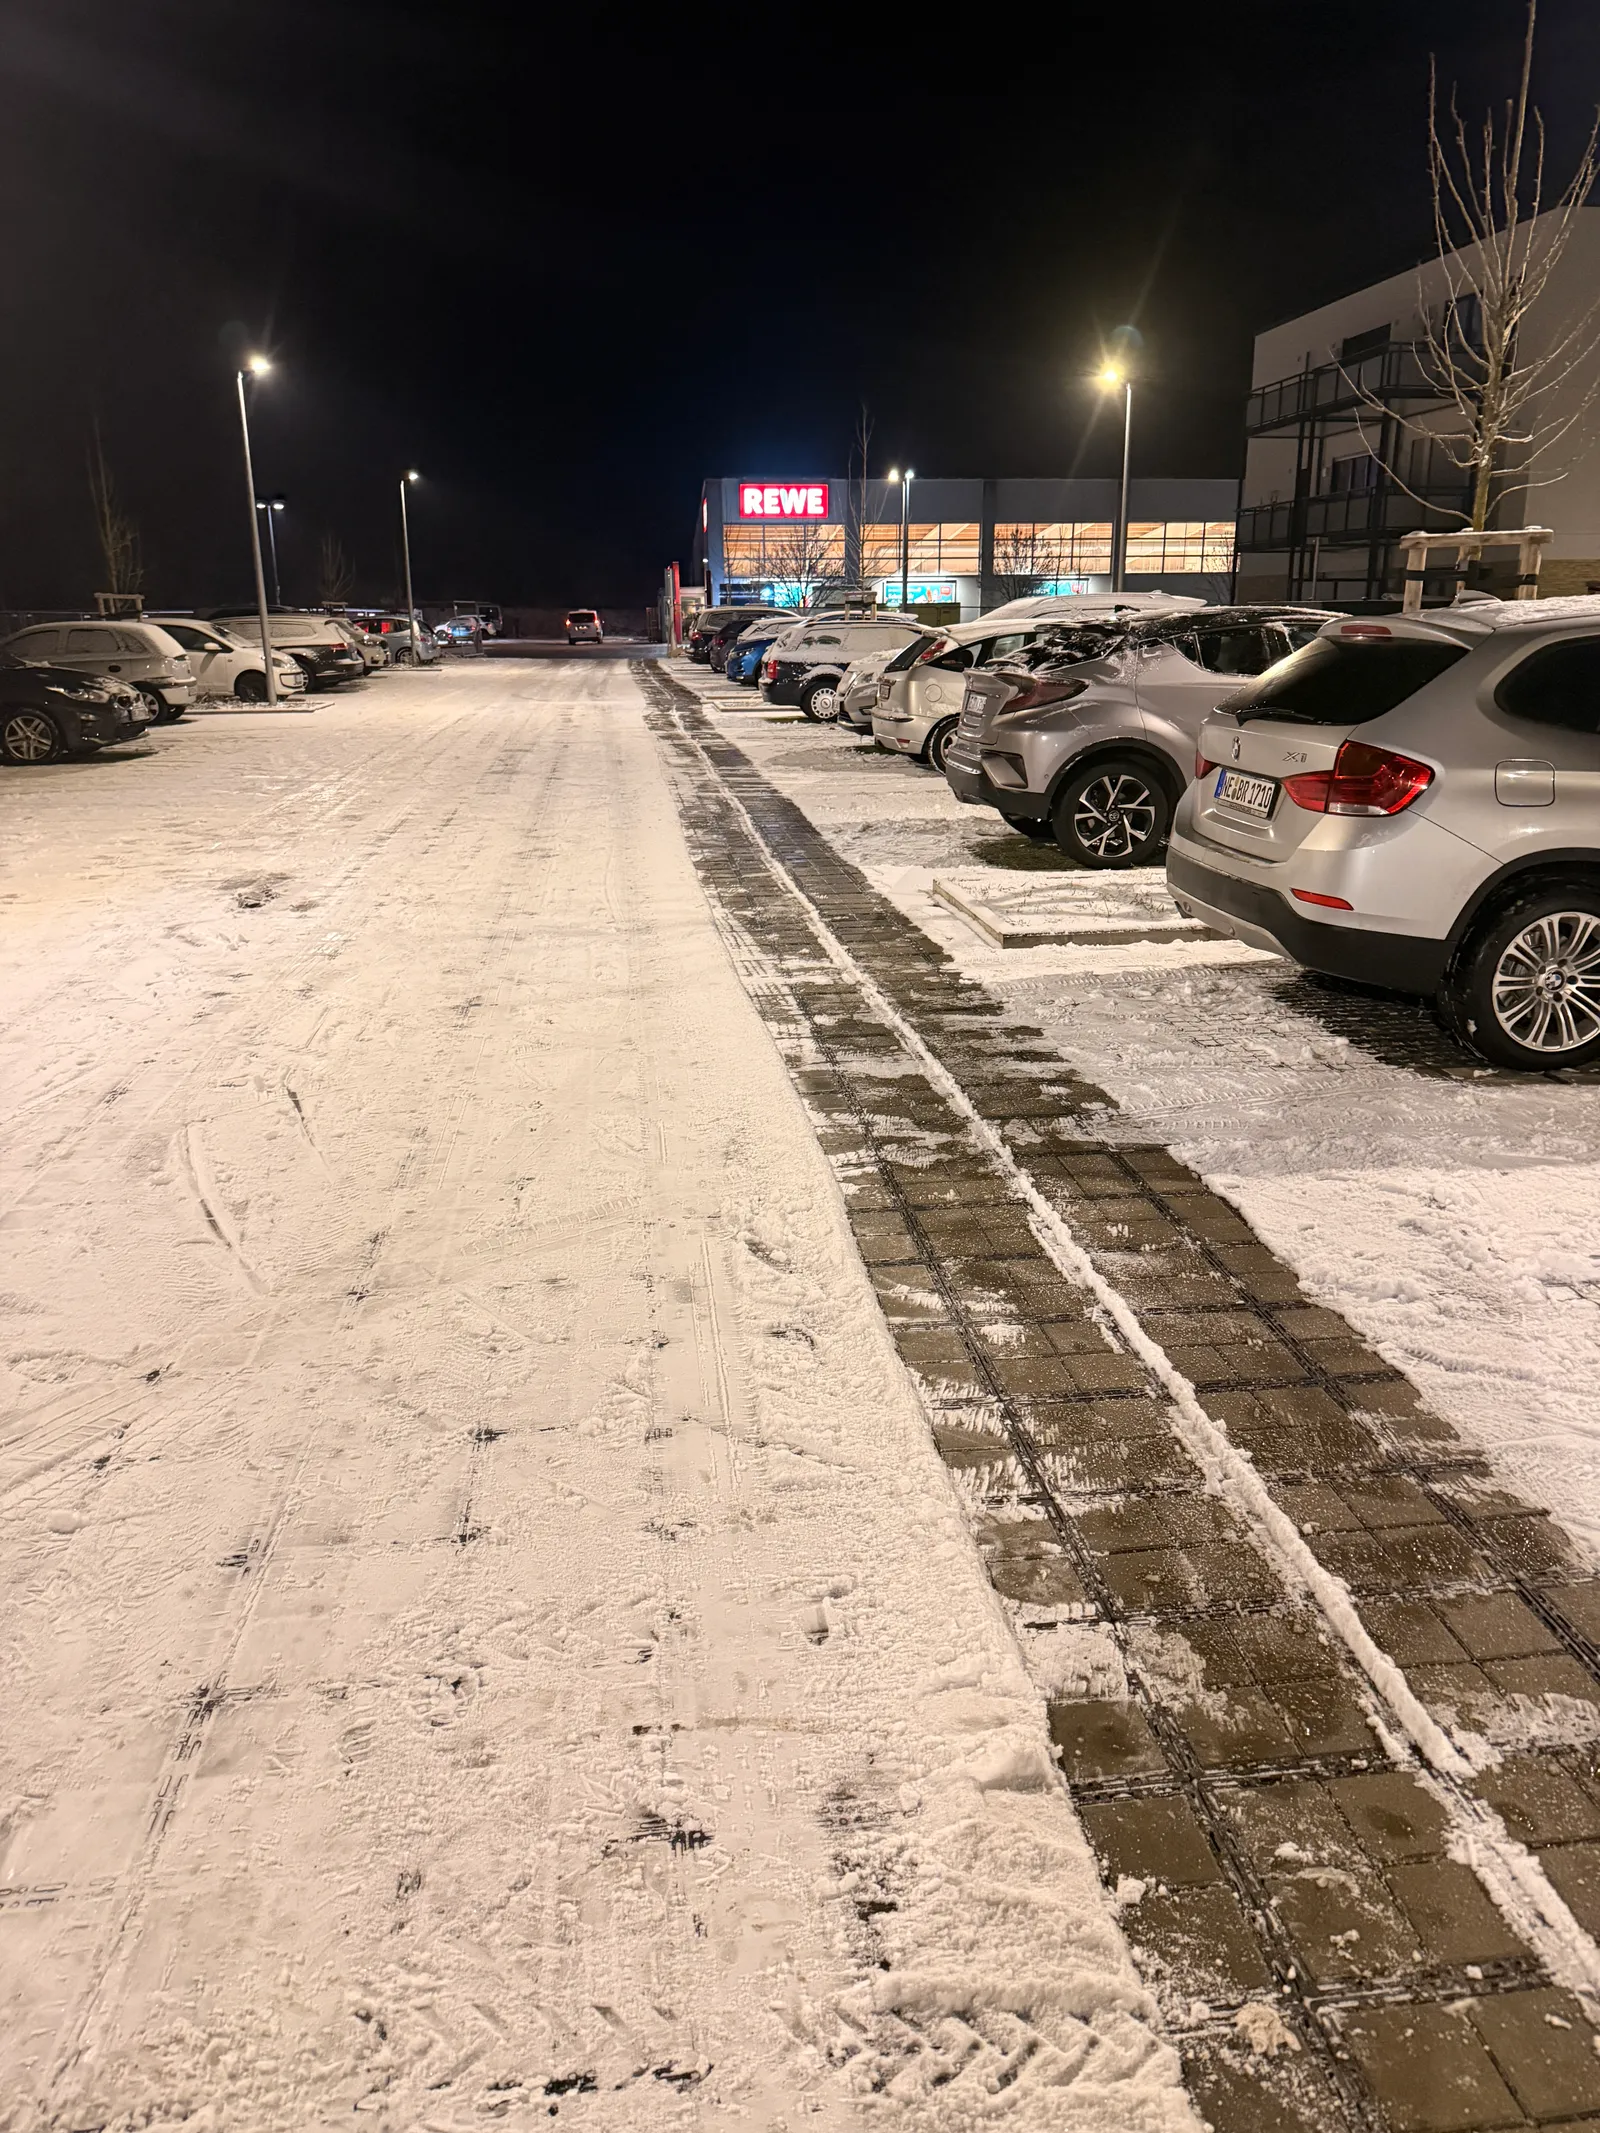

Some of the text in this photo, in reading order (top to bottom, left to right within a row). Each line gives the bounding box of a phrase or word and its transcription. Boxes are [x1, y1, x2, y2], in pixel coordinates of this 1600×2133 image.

[743, 487, 825, 515] REWE
[1282, 751, 1308, 763] X1
[1235, 779, 1250, 803] BR
[1247, 782, 1273, 809] 1710
